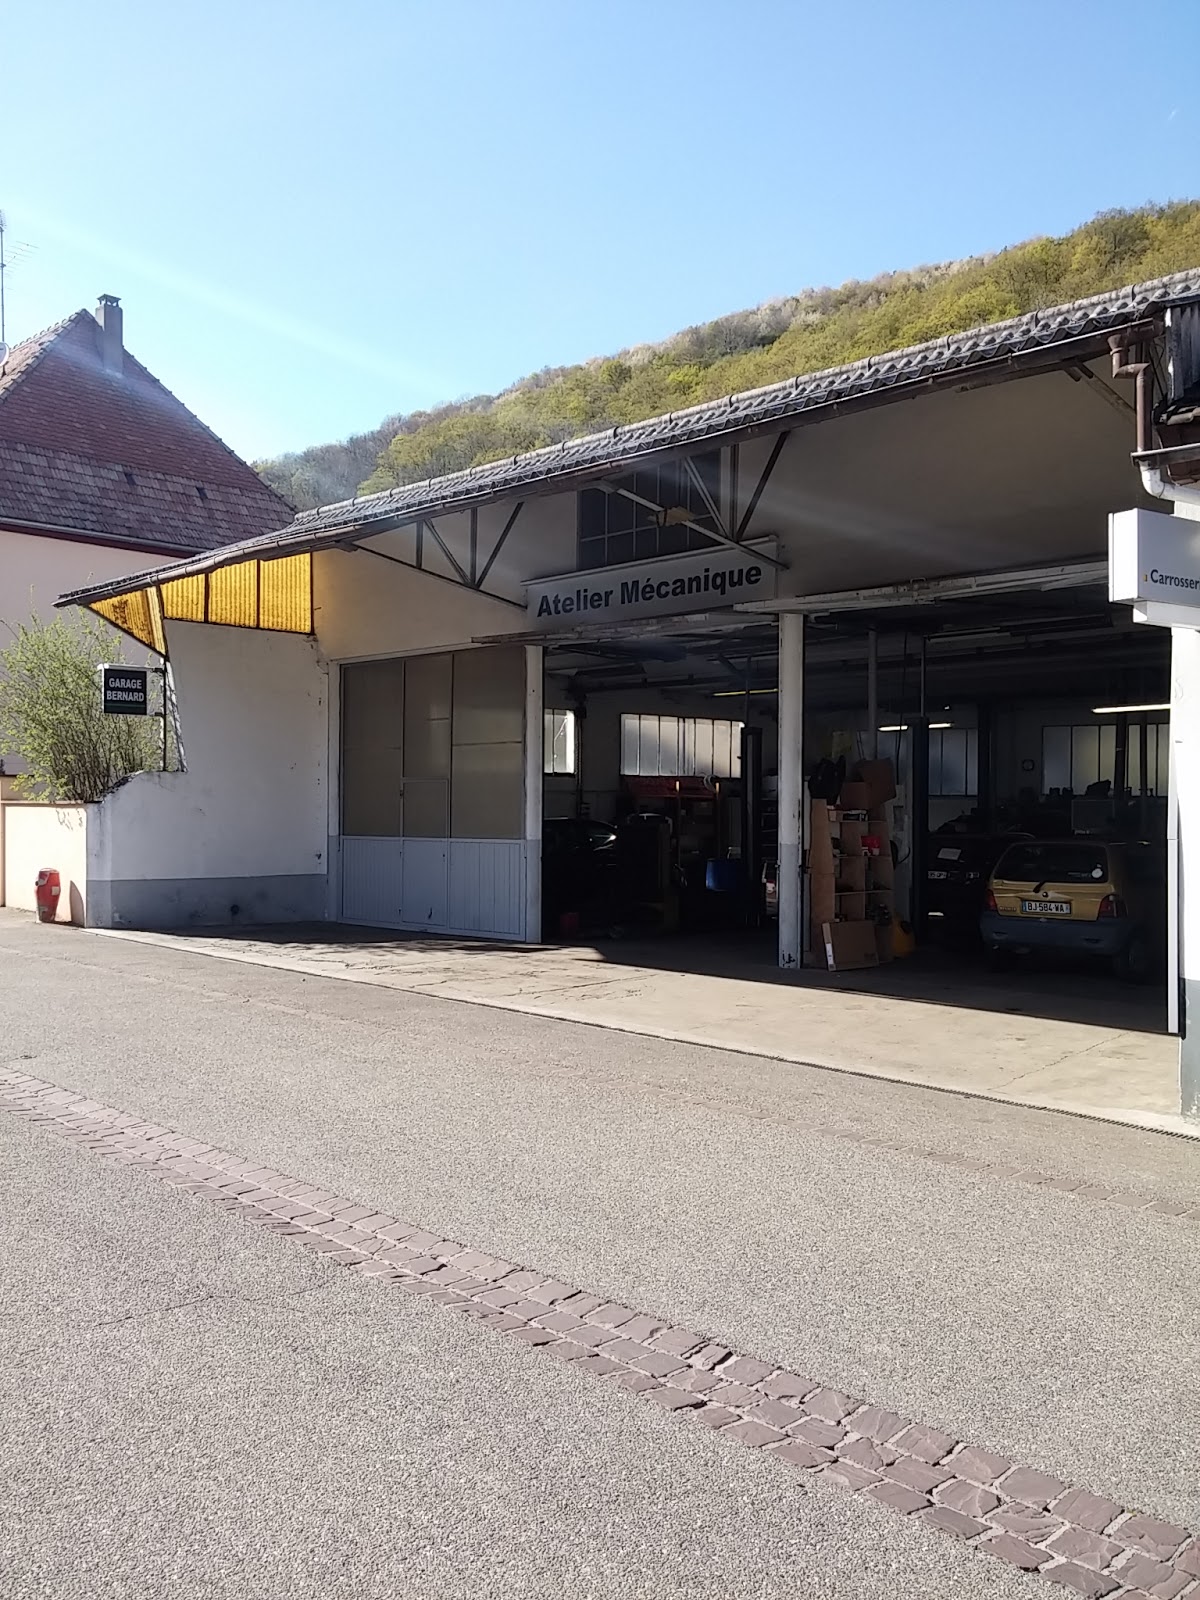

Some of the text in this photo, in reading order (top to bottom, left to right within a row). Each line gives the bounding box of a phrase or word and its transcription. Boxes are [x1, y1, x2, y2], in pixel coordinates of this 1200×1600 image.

[1150, 569, 1200, 590] Carrosser
[537, 565, 762, 617] Atelier Mécanique
[108, 678, 142, 689] GARAGE
[106, 690, 145, 702] BERNARD
